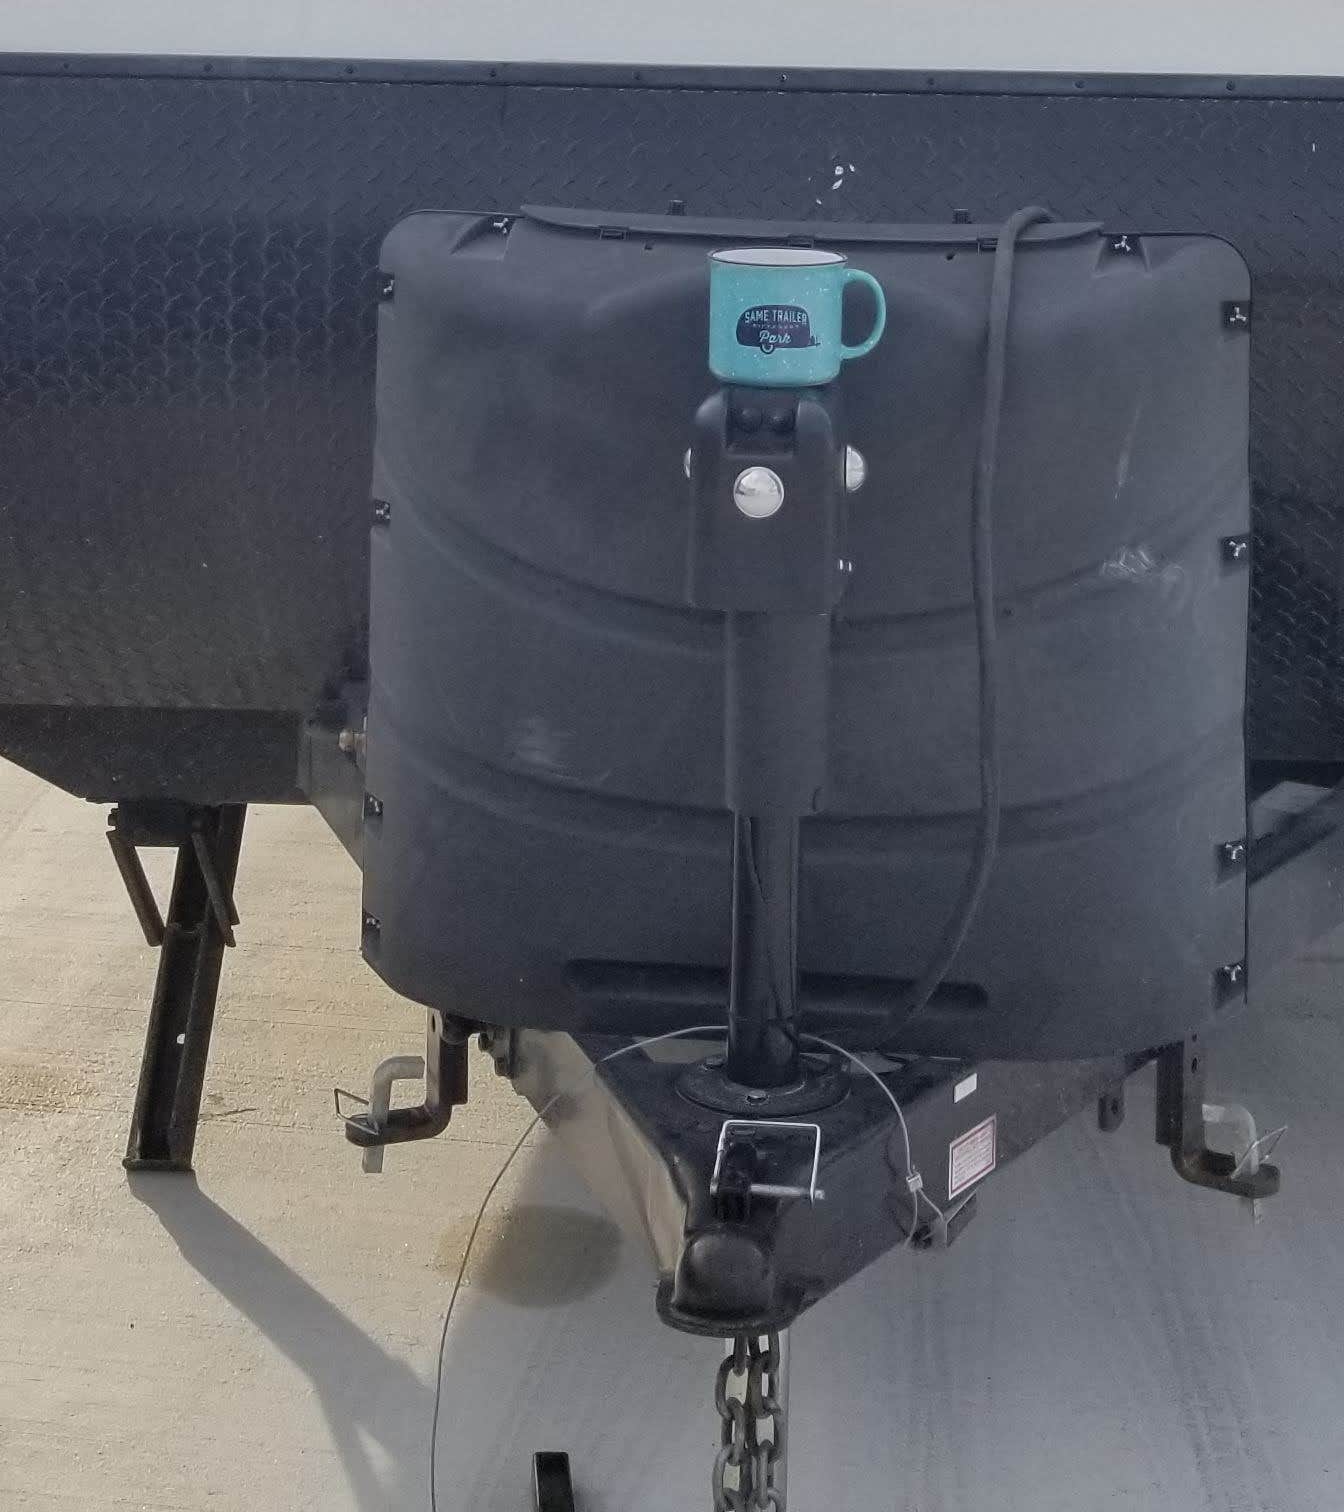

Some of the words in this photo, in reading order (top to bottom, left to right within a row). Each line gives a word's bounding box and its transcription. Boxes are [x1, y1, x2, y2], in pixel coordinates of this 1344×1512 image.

[744, 310, 769, 324] SAME
[773, 310, 808, 325] TRAILER
[759, 330, 792, 344] Park
